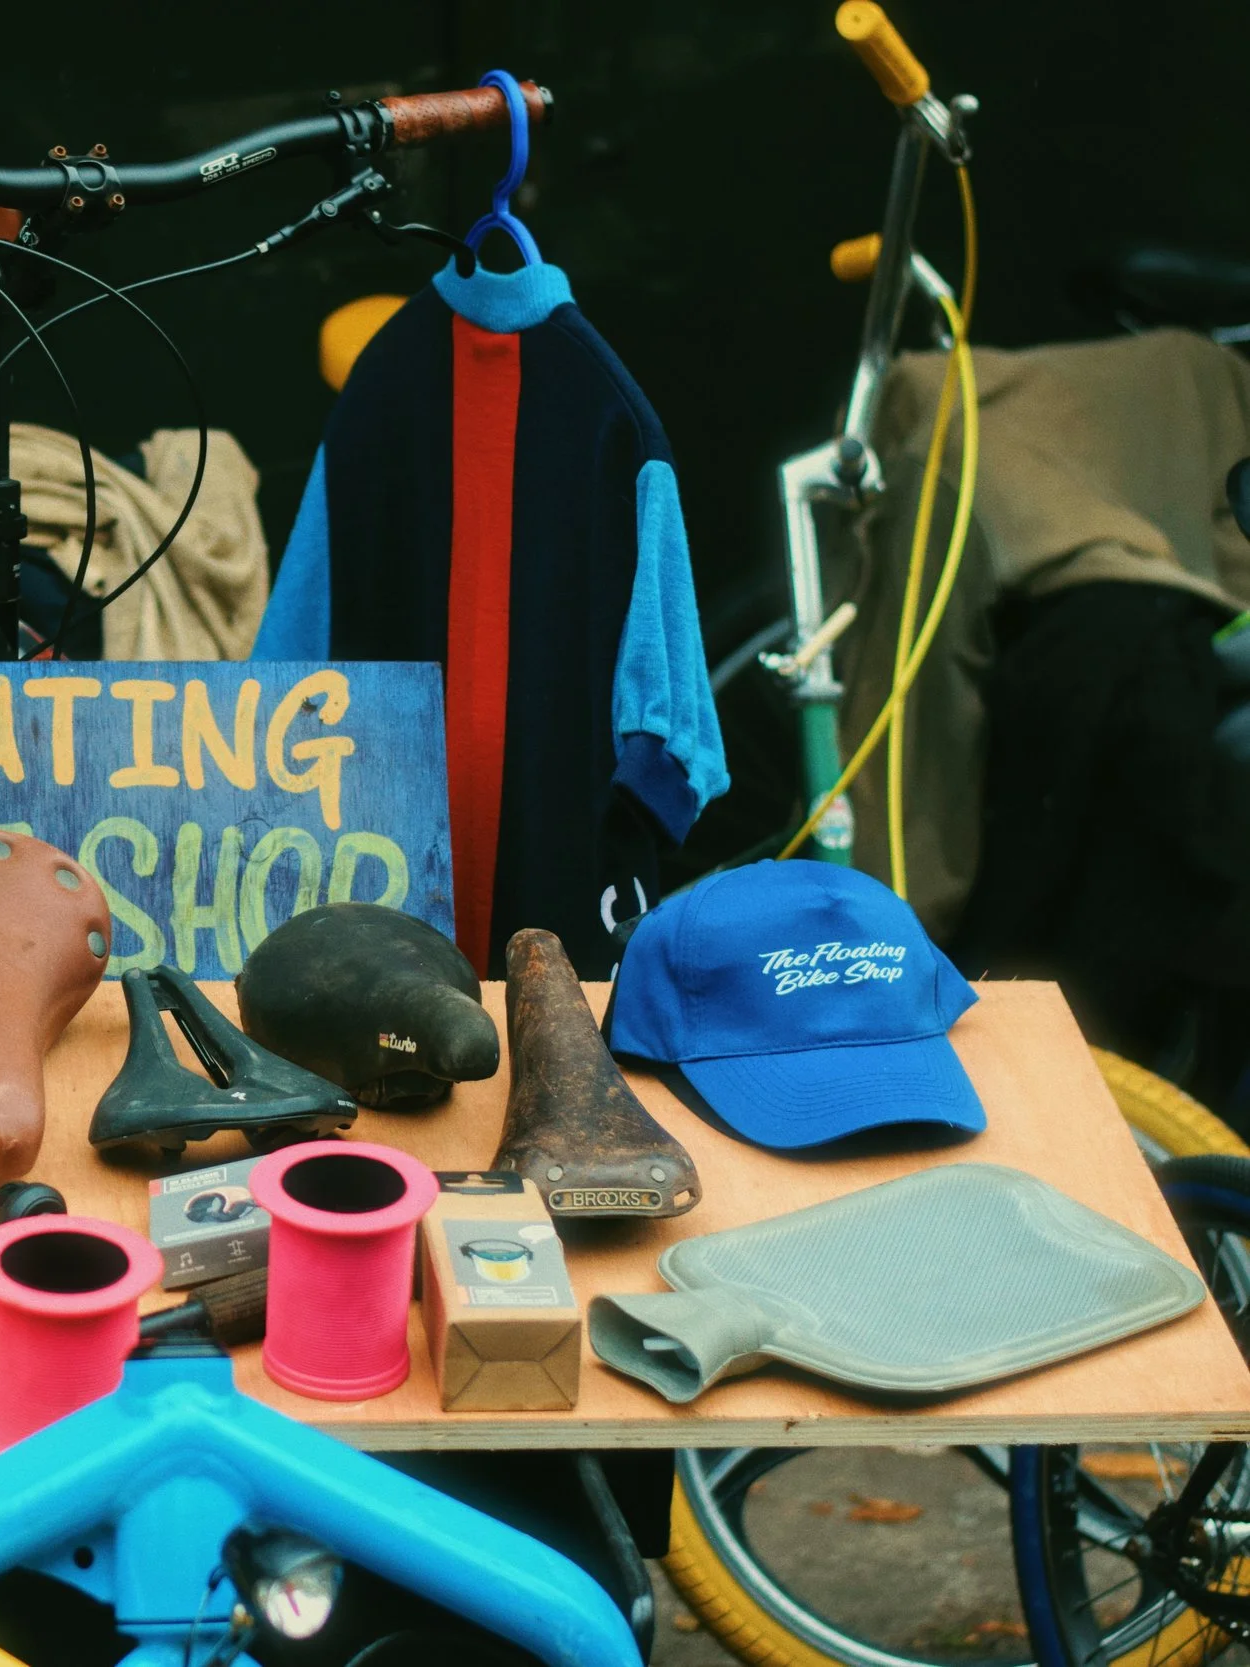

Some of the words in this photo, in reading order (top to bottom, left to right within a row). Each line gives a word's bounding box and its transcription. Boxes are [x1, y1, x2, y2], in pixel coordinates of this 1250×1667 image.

[758, 948, 811, 975] The
[809, 941, 907, 967] Floating
[775, 968, 841, 996] Bike
[843, 959, 904, 985] Shop
[389, 1032, 417, 1054] turbo
[573, 1192, 640, 1207] BROOKS
